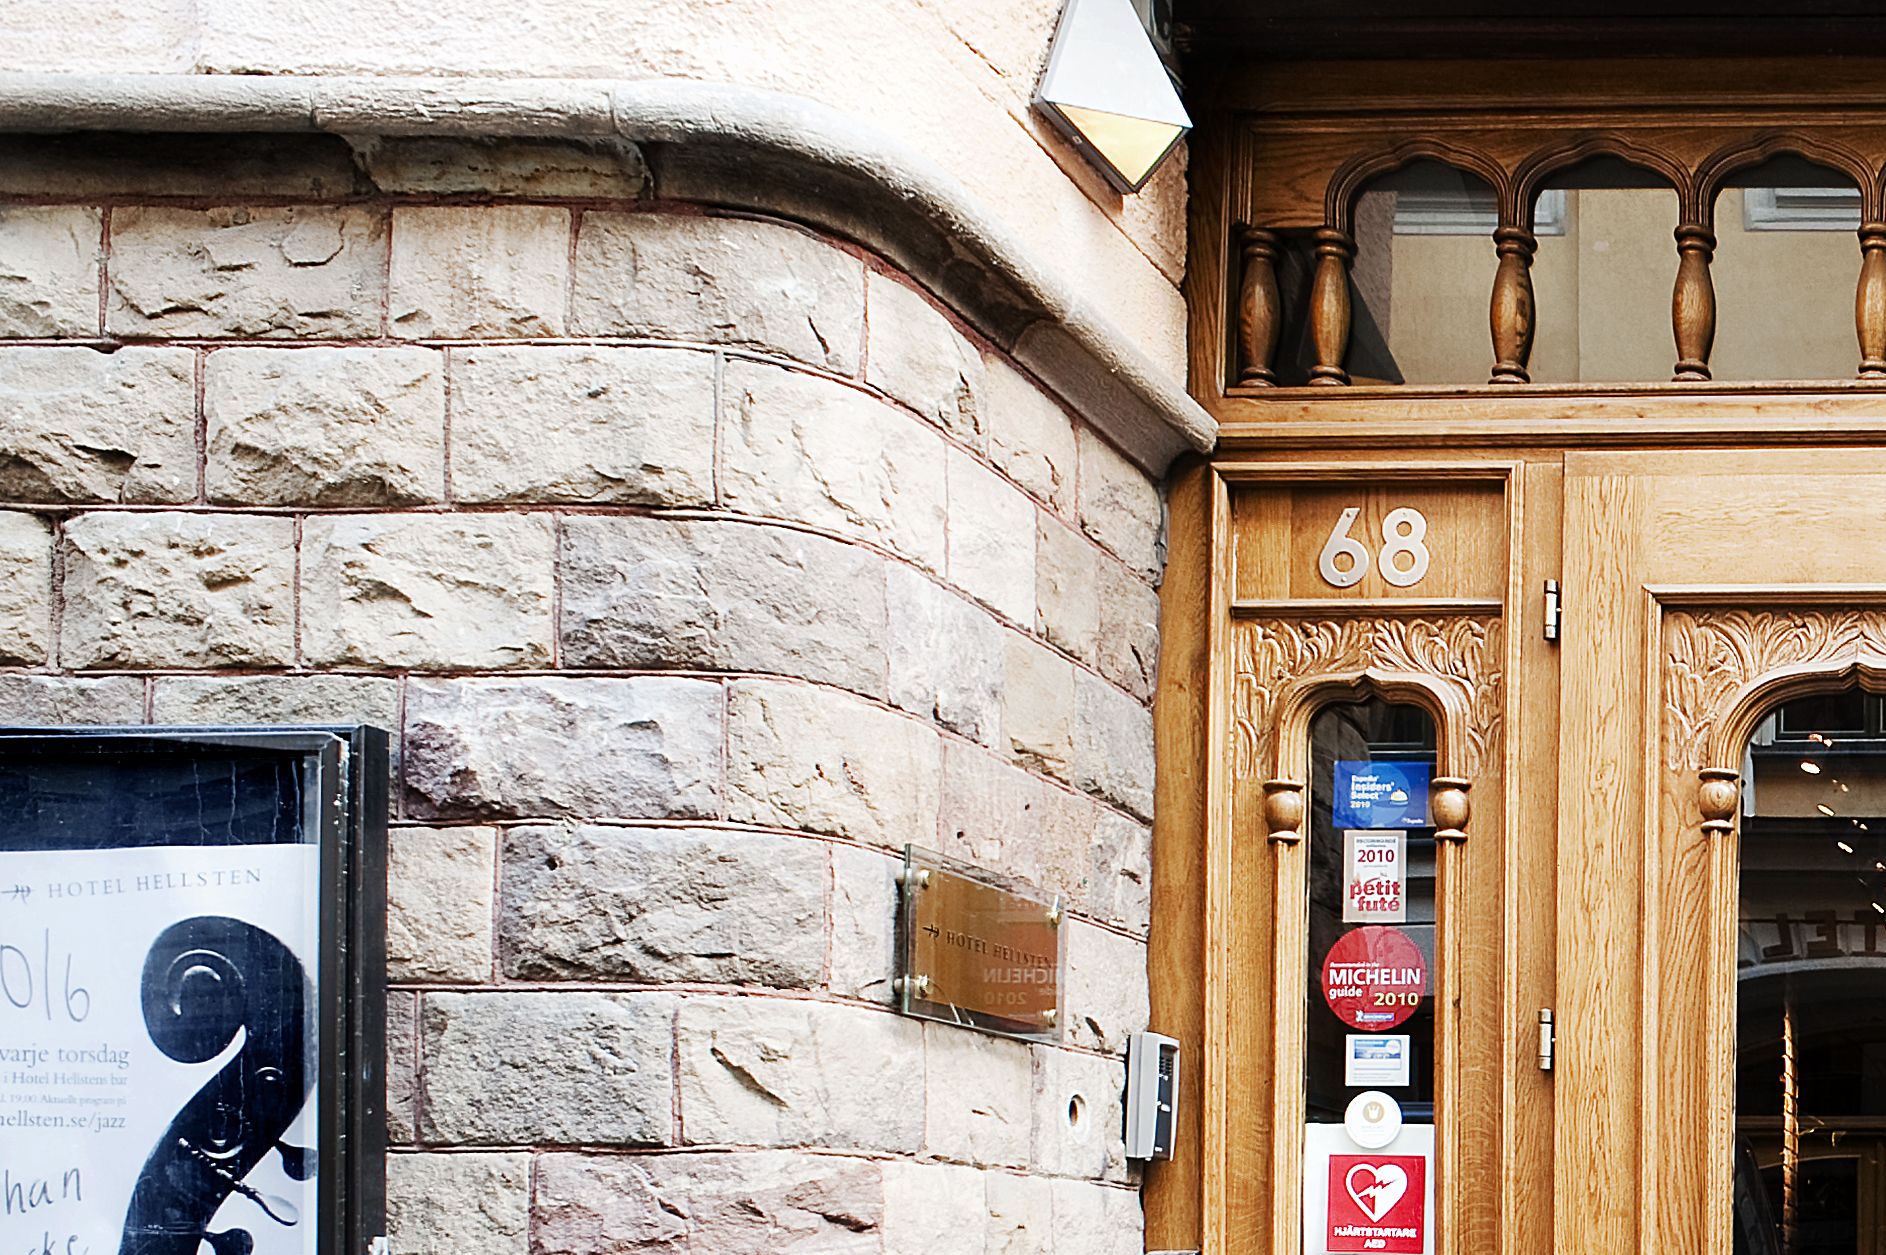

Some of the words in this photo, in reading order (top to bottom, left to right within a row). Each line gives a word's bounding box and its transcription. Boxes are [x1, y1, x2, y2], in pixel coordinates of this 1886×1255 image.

[1318, 506, 1430, 587] 68
[1358, 849, 1395, 863] 2010
[48, 878, 126, 898] HOTEL
[136, 868, 262, 892] HELLSTEN
[1350, 880, 1400, 899] petit
[1357, 896, 1400, 912] futé
[946, 930, 989, 954] HOTEL
[993, 942, 1052, 969] HELLSTEN
[1329, 968, 1421, 986] MICHELIN
[1329, 986, 1363, 1000] guide
[1373, 992, 1419, 1006] 2010
[58, 1043, 130, 1069] torsdag
[12, 1072, 49, 1085] Hotel
[54, 1072, 107, 1085] Hellstens
[1363, 1238, 1387, 1249] AED
